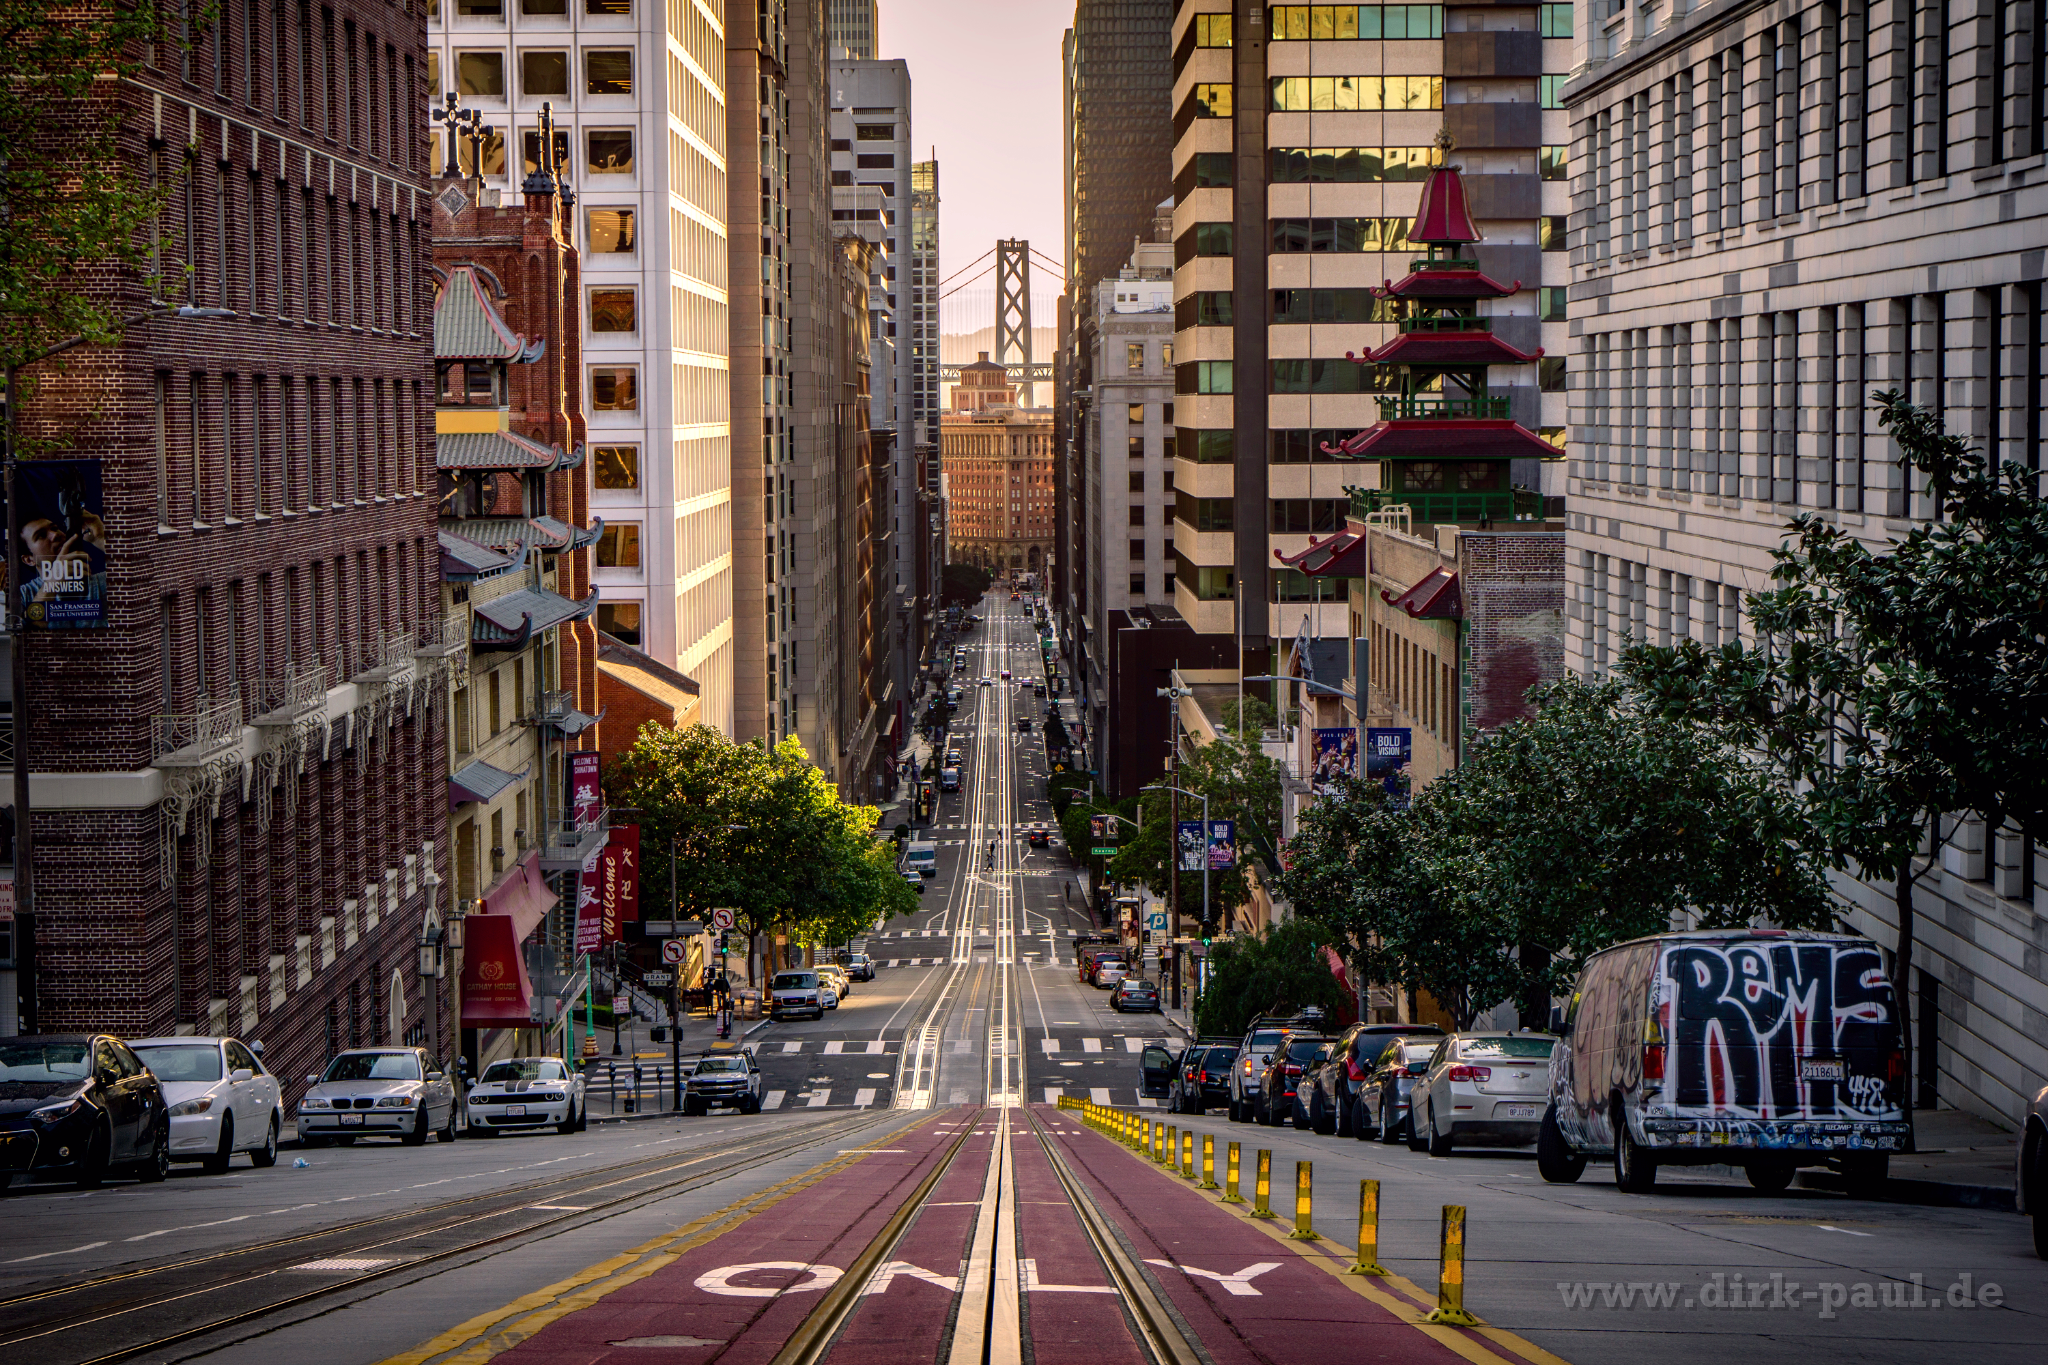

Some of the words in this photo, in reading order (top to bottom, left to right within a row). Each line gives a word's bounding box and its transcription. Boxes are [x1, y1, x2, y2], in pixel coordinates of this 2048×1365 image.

[41, 559, 84, 581] BOLD
[43, 581, 85, 593] ANSWERS
[64, 602, 100, 610] FRANCISCO
[1378, 735, 1401, 747] BOLD
[1378, 746, 1400, 756] VISION
[573, 757, 592, 766] WELCOME
[593, 756, 598, 765] TO
[574, 765, 597, 774] CHINATOWN
[1214, 824, 1229, 832] BOLD
[603, 856, 616, 936] Welcome
[466, 983, 493, 991] CATHAY
[494, 982, 517, 991] HOUSE
[1804, 1067, 1841, 1078] 21186L1
[1509, 1108, 1535, 1117] 8PJJ789
[694, 1258, 1283, 1298] ONLY
